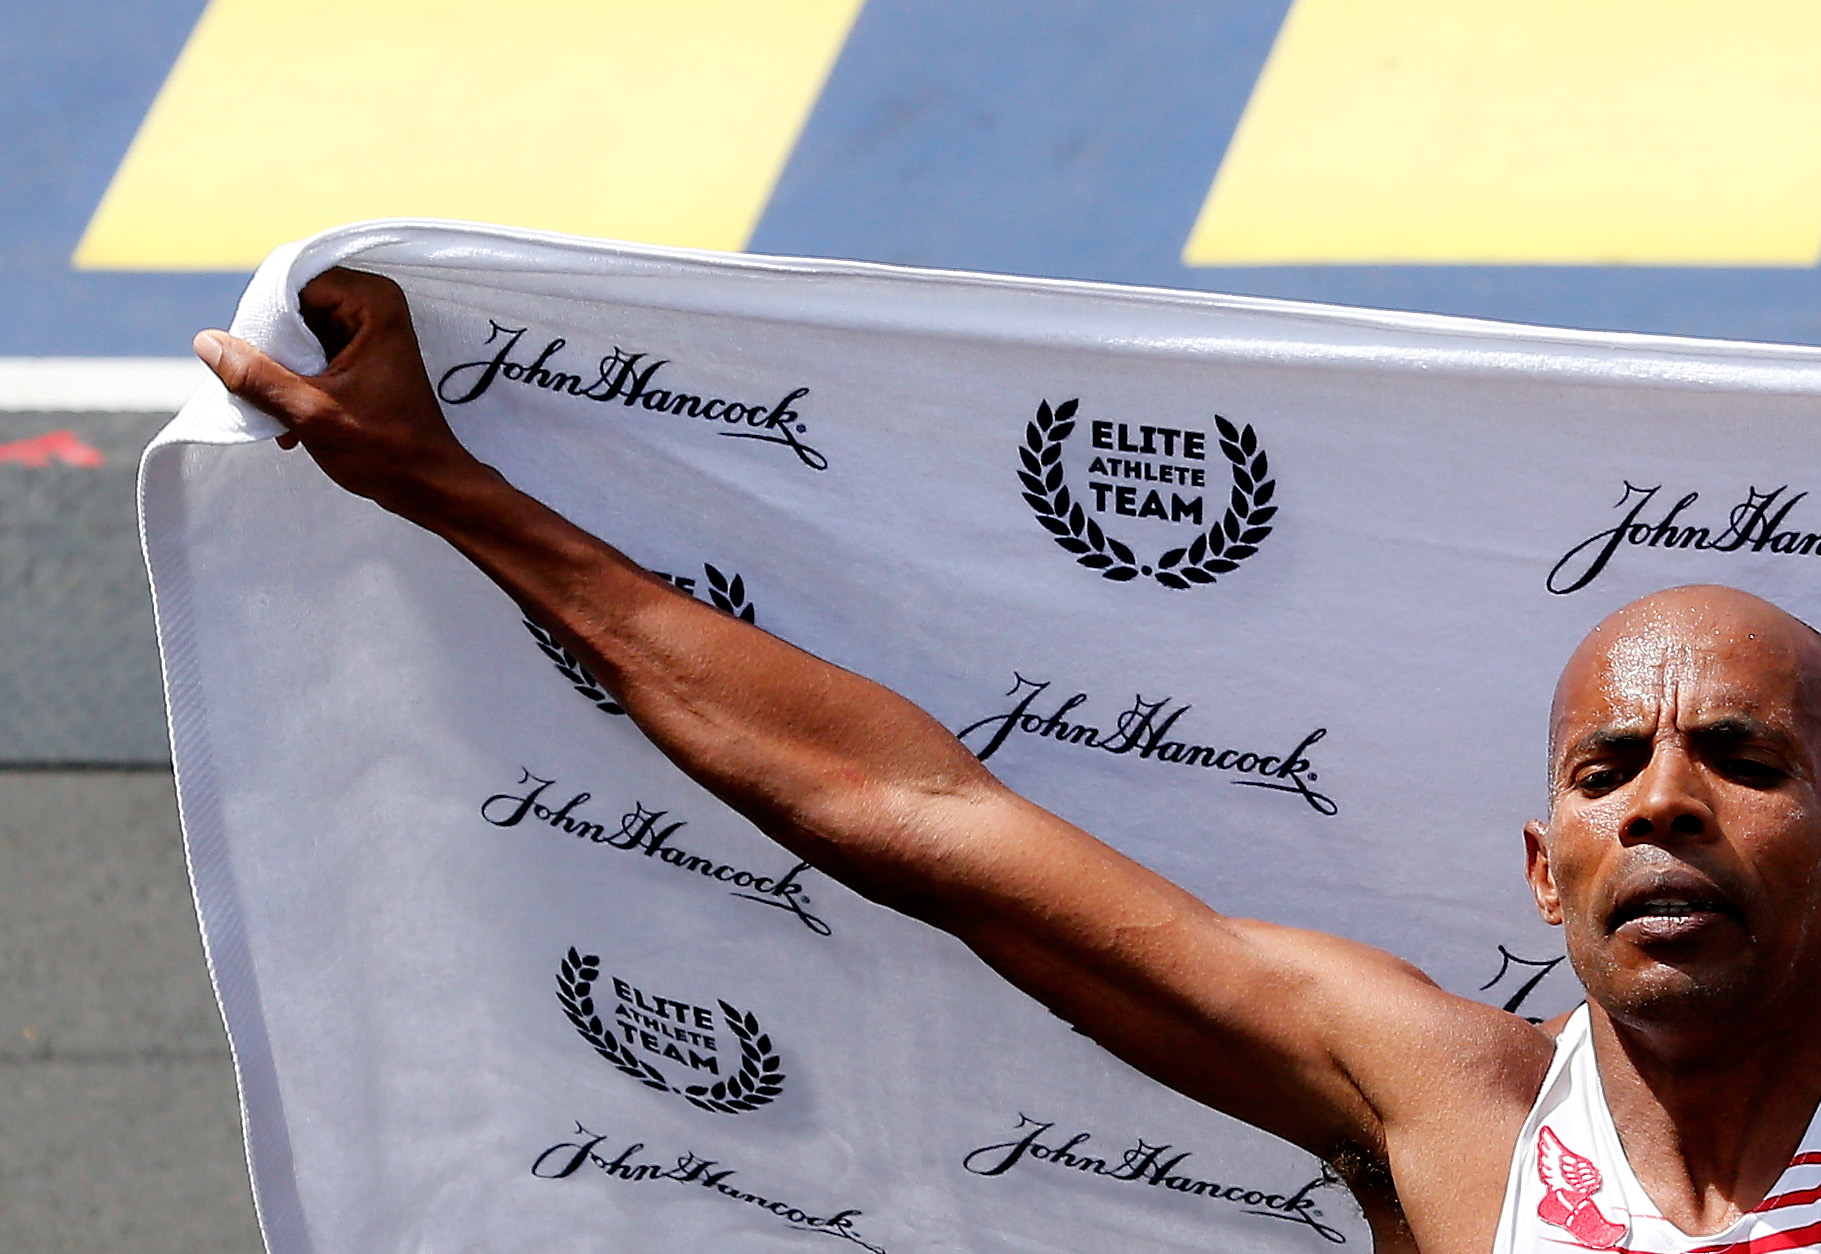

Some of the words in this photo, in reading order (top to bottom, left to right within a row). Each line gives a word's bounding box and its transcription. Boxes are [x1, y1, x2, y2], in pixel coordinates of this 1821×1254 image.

[437, 319, 583, 404] John
[1091, 420, 1206, 460] ELITE
[1088, 456, 1206, 487] ATHLETE
[1089, 481, 1204, 525] TEAM
[1546, 480, 1711, 594] John
[955, 671, 1102, 763] John
[481, 766, 607, 843] John
[611, 976, 714, 1031] ELITE
[615, 1003, 717, 1052] ATHLETE
[617, 1019, 719, 1075] TEAM
[531, 1121, 663, 1180] John
[963, 1112, 1108, 1176] John
